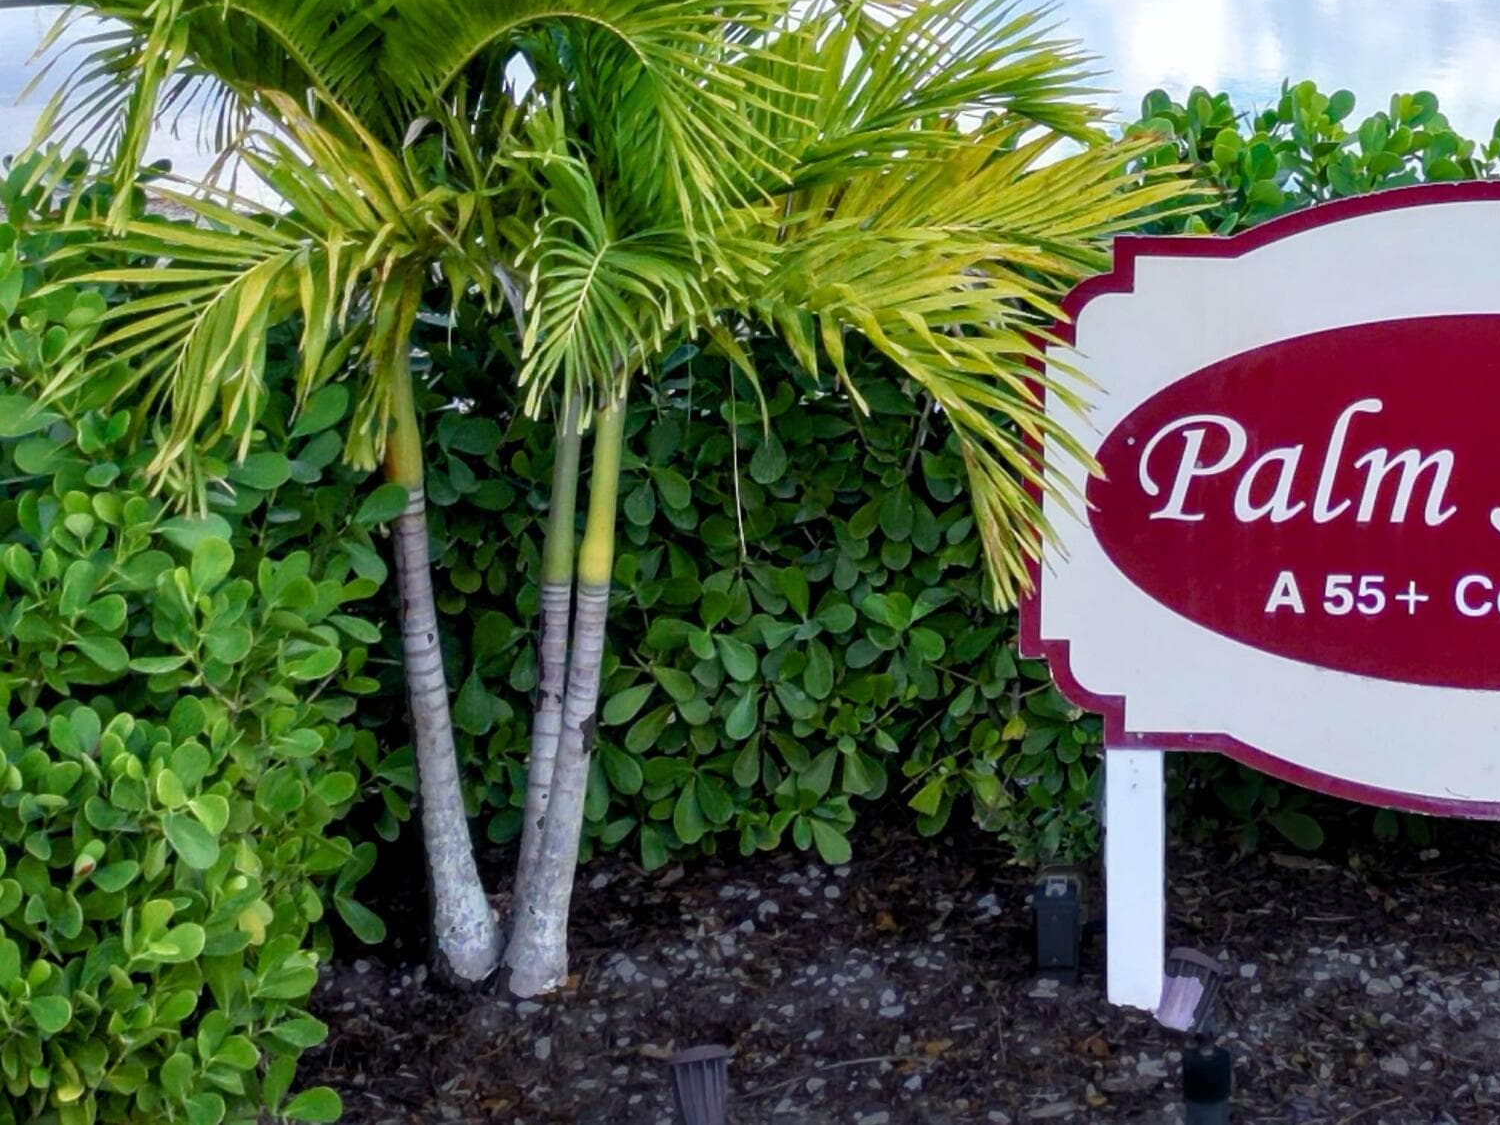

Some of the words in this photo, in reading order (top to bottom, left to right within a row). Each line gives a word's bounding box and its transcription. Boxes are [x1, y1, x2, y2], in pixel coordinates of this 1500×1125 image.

[1138, 397, 1457, 526] Palm
[1264, 570, 1306, 615] A
[1322, 574, 1430, 616] 55+
